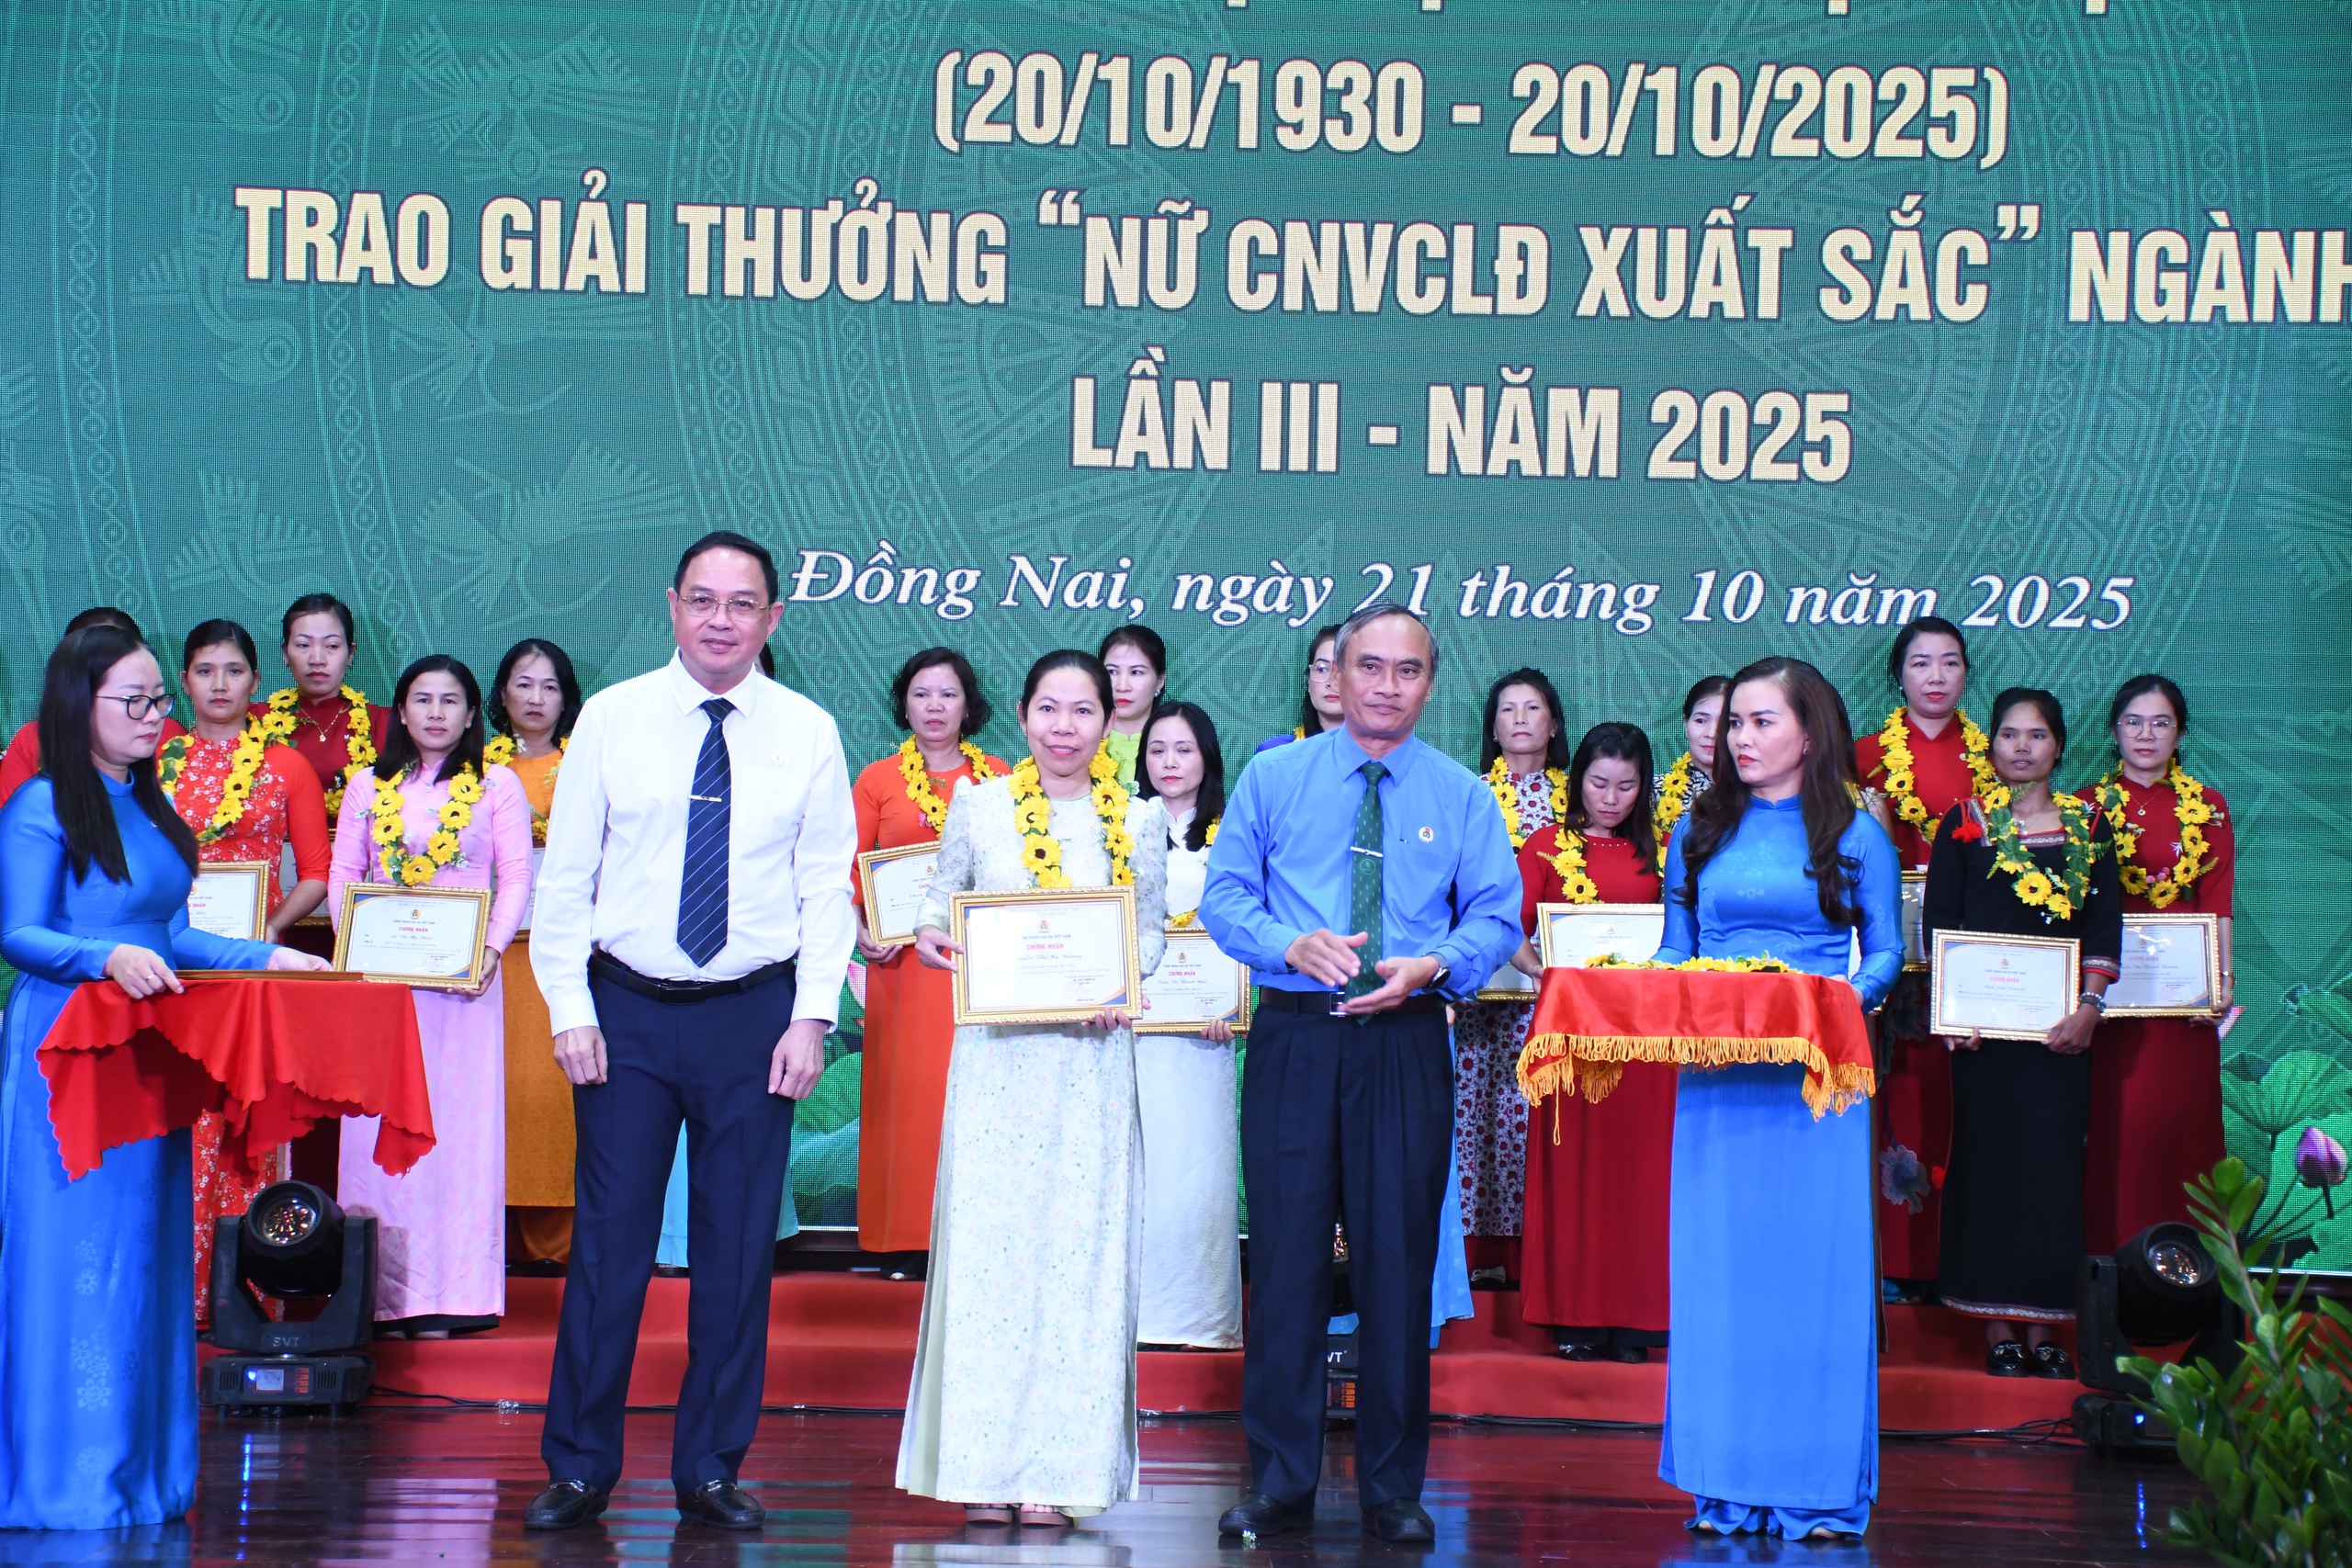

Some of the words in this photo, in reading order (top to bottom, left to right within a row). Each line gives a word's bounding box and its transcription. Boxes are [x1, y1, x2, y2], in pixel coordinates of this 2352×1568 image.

[935, 51, 1423, 152] (20/10/1930
[1510, 63, 2007, 168] 20/10/2025)
[235, 186, 449, 287] TRAO
[481, 169, 647, 293] GIẢI
[676, 178, 1006, 304] THƯỞNG
[1039, 189, 1209, 309] “NỮ
[1227, 219, 1548, 315] CNVCLĐ
[1577, 195, 1793, 319] XUẤT
[1820, 194, 2040, 321] SẮC”
[2069, 210, 2352, 322] NGÀNH
[1072, 346, 1230, 469] LẦN
[1261, 381, 1339, 472] III
[1428, 367, 1620, 478] NĂM
[1648, 389, 1851, 482] 2025
[788, 539, 981, 620] Đồng
[1000, 555, 1144, 618] Nai,
[1172, 560, 1334, 627] ngày
[1351, 562, 1434, 615] 21
[1459, 564, 1660, 634] tháng
[1685, 570, 1765, 623] 10
[1786, 572, 1938, 626] năm
[1960, 574, 2134, 629] 2025
[273, 1337, 300, 1348] SVT
[1328, 1351, 1342, 1363] VT
